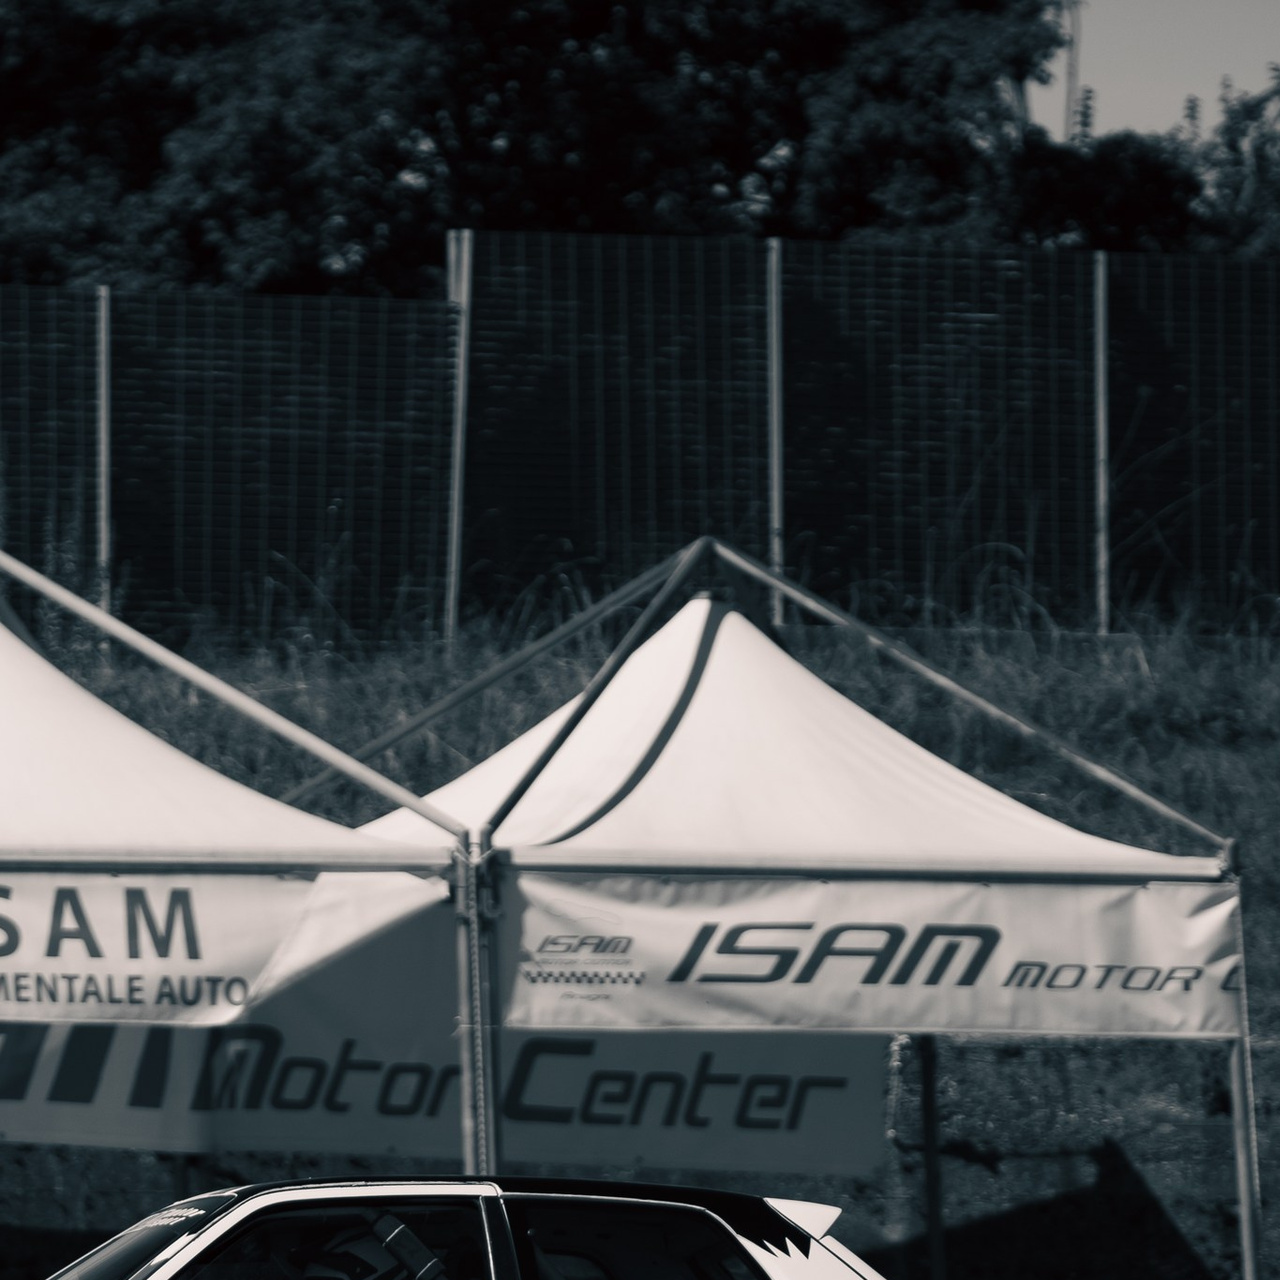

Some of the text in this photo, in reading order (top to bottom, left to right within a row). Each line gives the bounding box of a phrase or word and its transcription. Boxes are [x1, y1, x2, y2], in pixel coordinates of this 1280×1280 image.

[536, 935, 634, 953] ISAM
[666, 922, 1001, 987] ISAM
[1003, 961, 1205, 992] MOTOR
[155, 975, 249, 1006] AUTO
[188, 1022, 462, 1118] Motor
[501, 1036, 850, 1132] Center
